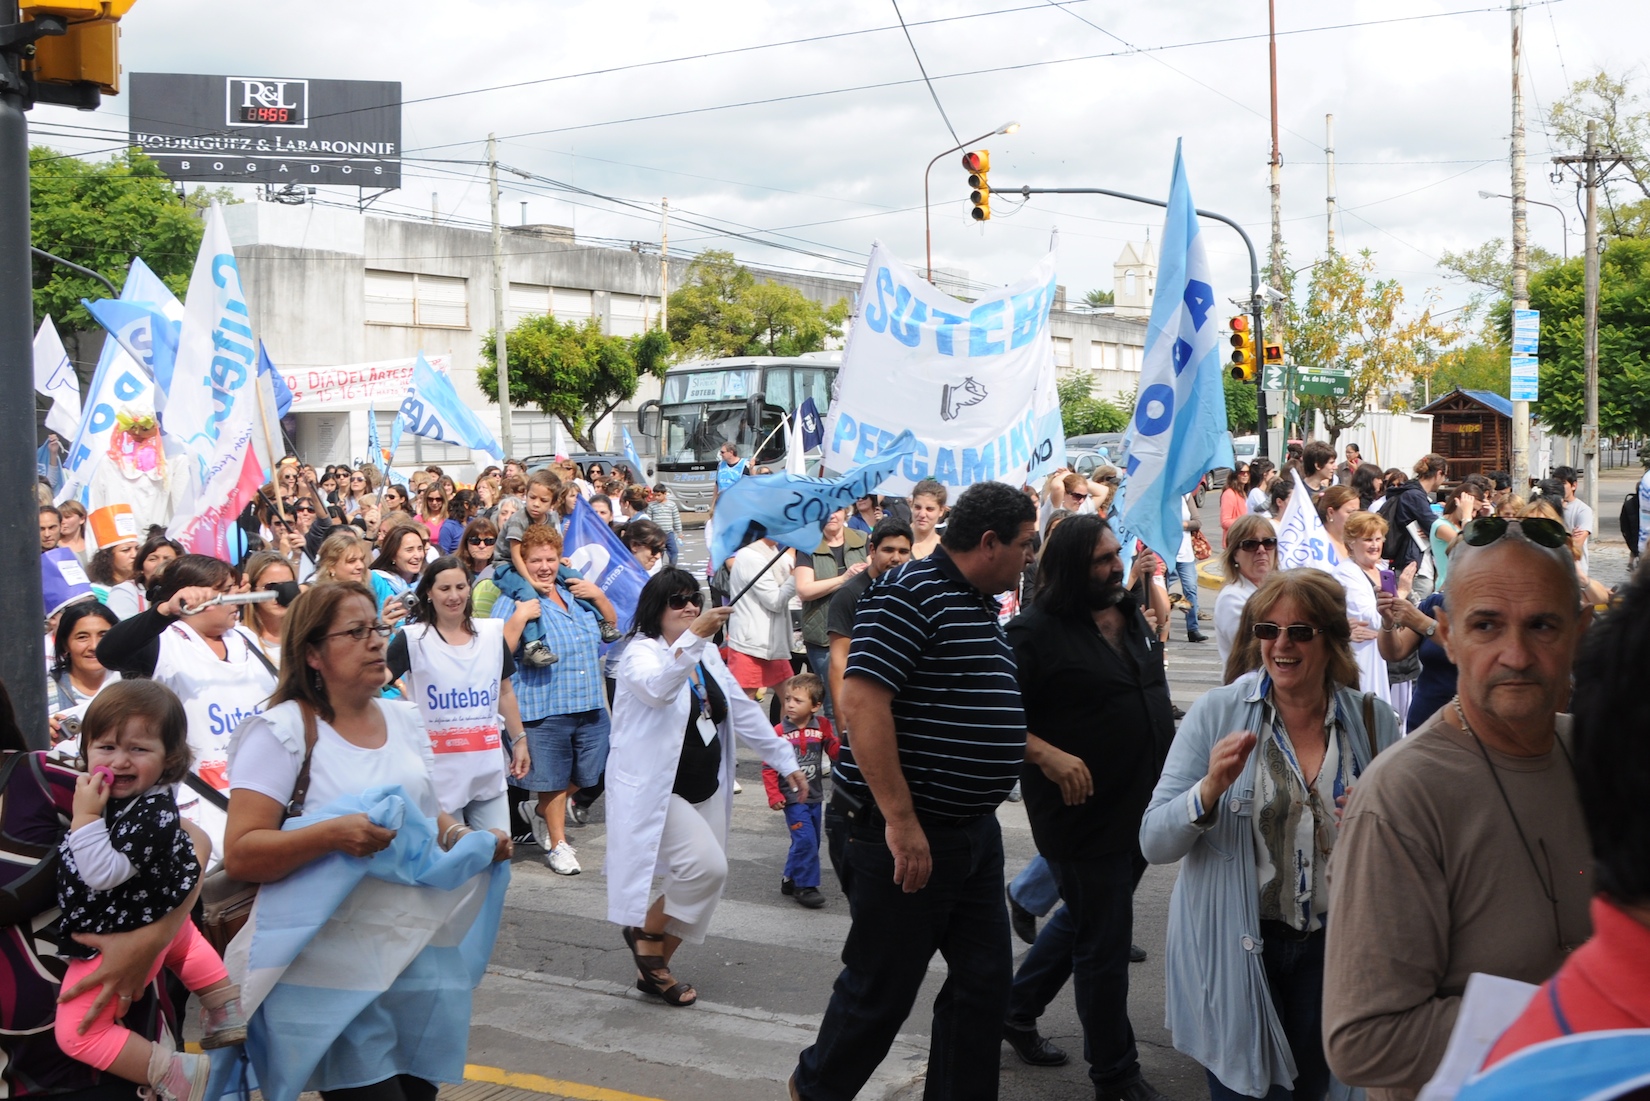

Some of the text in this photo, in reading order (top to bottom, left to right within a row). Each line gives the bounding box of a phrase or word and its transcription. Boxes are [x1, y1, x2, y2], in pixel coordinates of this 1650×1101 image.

[241, 81, 297, 109] R&L
[256, 138, 272, 152] &
[275, 135, 395, 155] LABARONNIE
[1320, 376, 1336, 384] Mayo
[427, 684, 490, 710] Suteba
